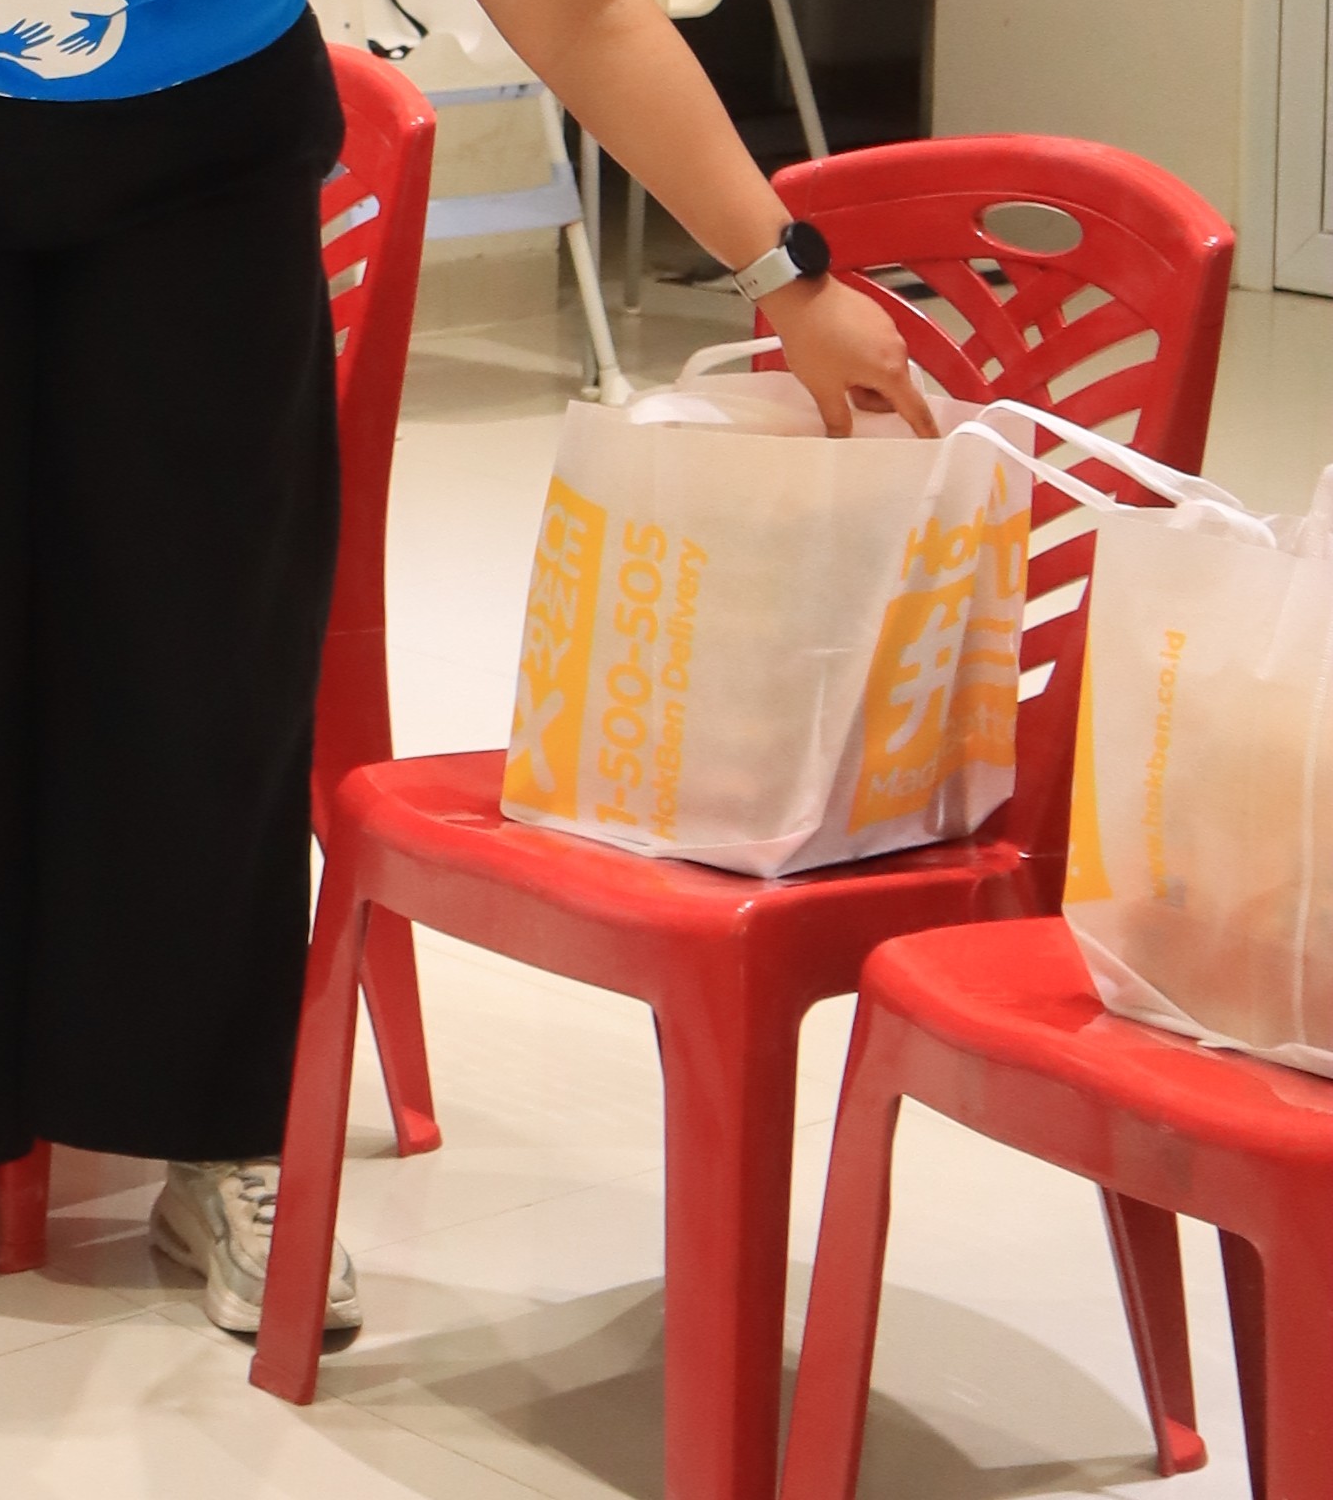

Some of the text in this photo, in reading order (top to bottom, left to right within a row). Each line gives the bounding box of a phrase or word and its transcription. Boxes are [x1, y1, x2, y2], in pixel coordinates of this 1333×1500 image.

[595, 518, 668, 827] 1-500-505
[648, 536, 709, 843] HokBen Delivery
